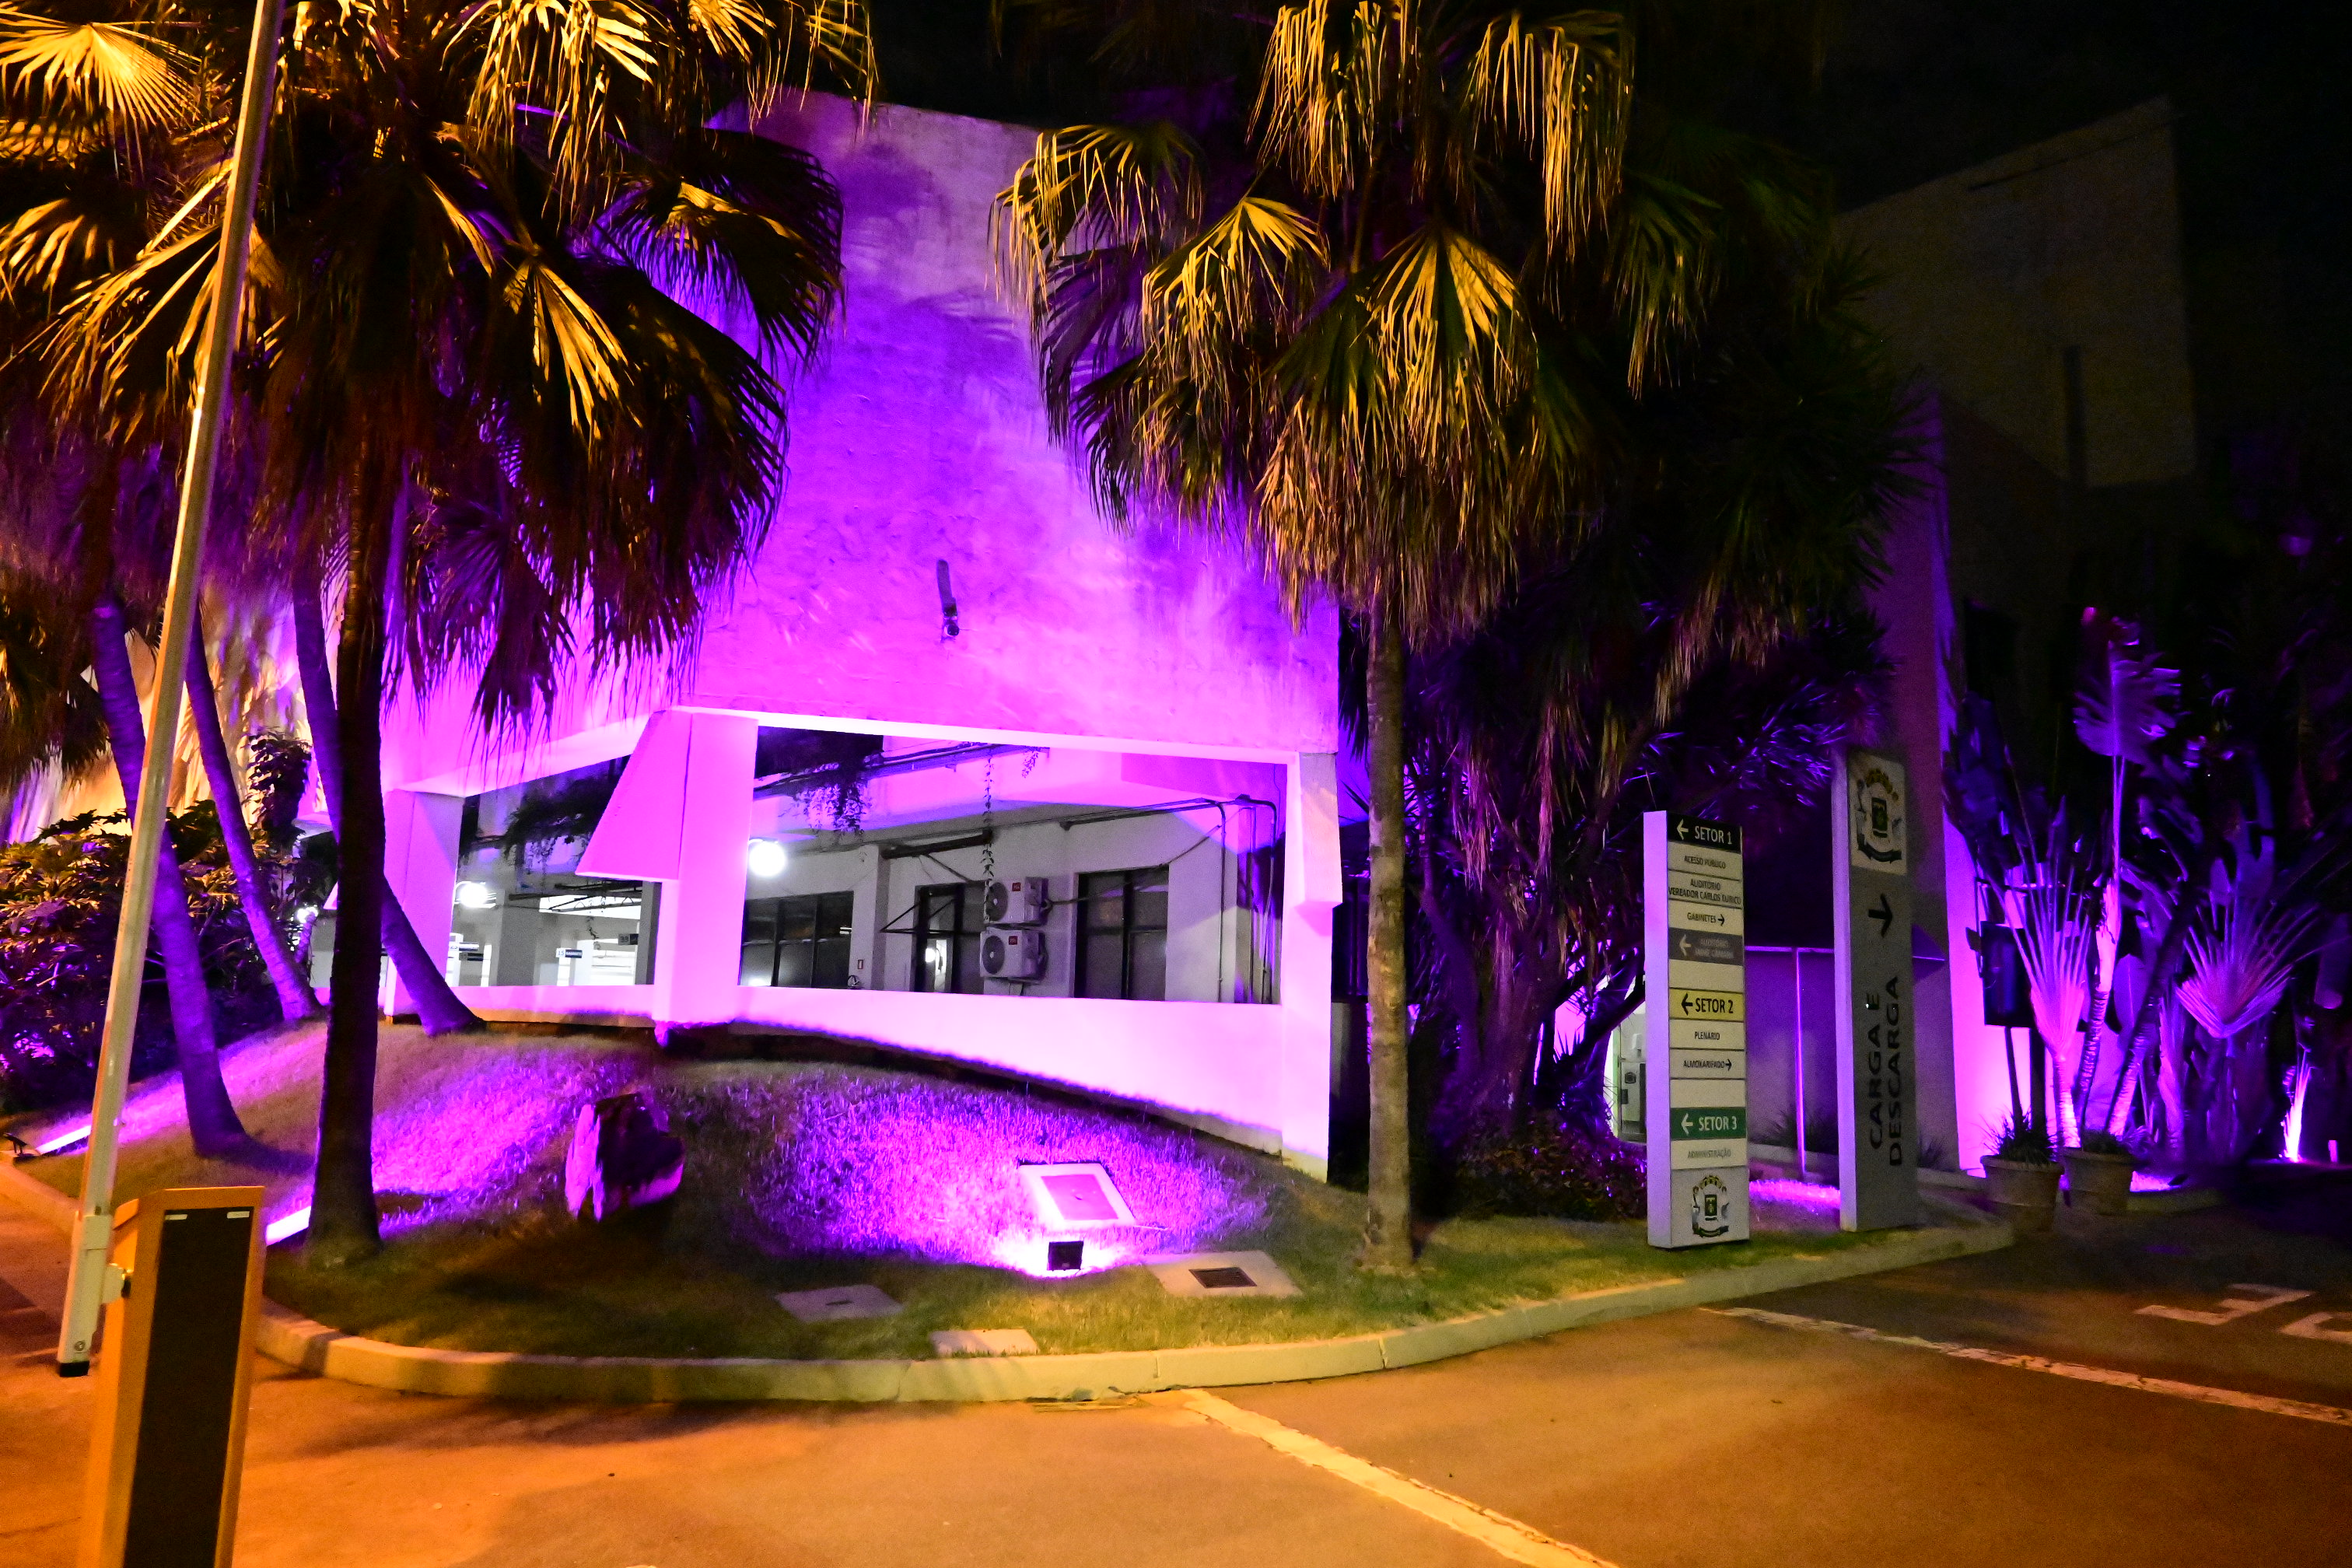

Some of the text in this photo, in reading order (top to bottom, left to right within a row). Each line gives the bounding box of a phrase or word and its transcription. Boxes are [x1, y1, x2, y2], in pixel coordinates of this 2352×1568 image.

[1695, 825, 1733, 845] SETOR 1
[1684, 856, 1703, 866] ACESSO
[1668, 887, 1699, 898] VEREADOR
[1699, 891, 1720, 901] CARLOS
[1687, 912, 1717, 923] GABINETES
[1696, 998, 1734, 1013] SETOR 2
[1683, 1060, 1724, 1069] ALMOXARIFADO
[1867, 992, 1883, 1149] CARGA E
[1885, 976, 1902, 1166] DESCARGA
[1699, 1115, 1738, 1131] SETOR 3
